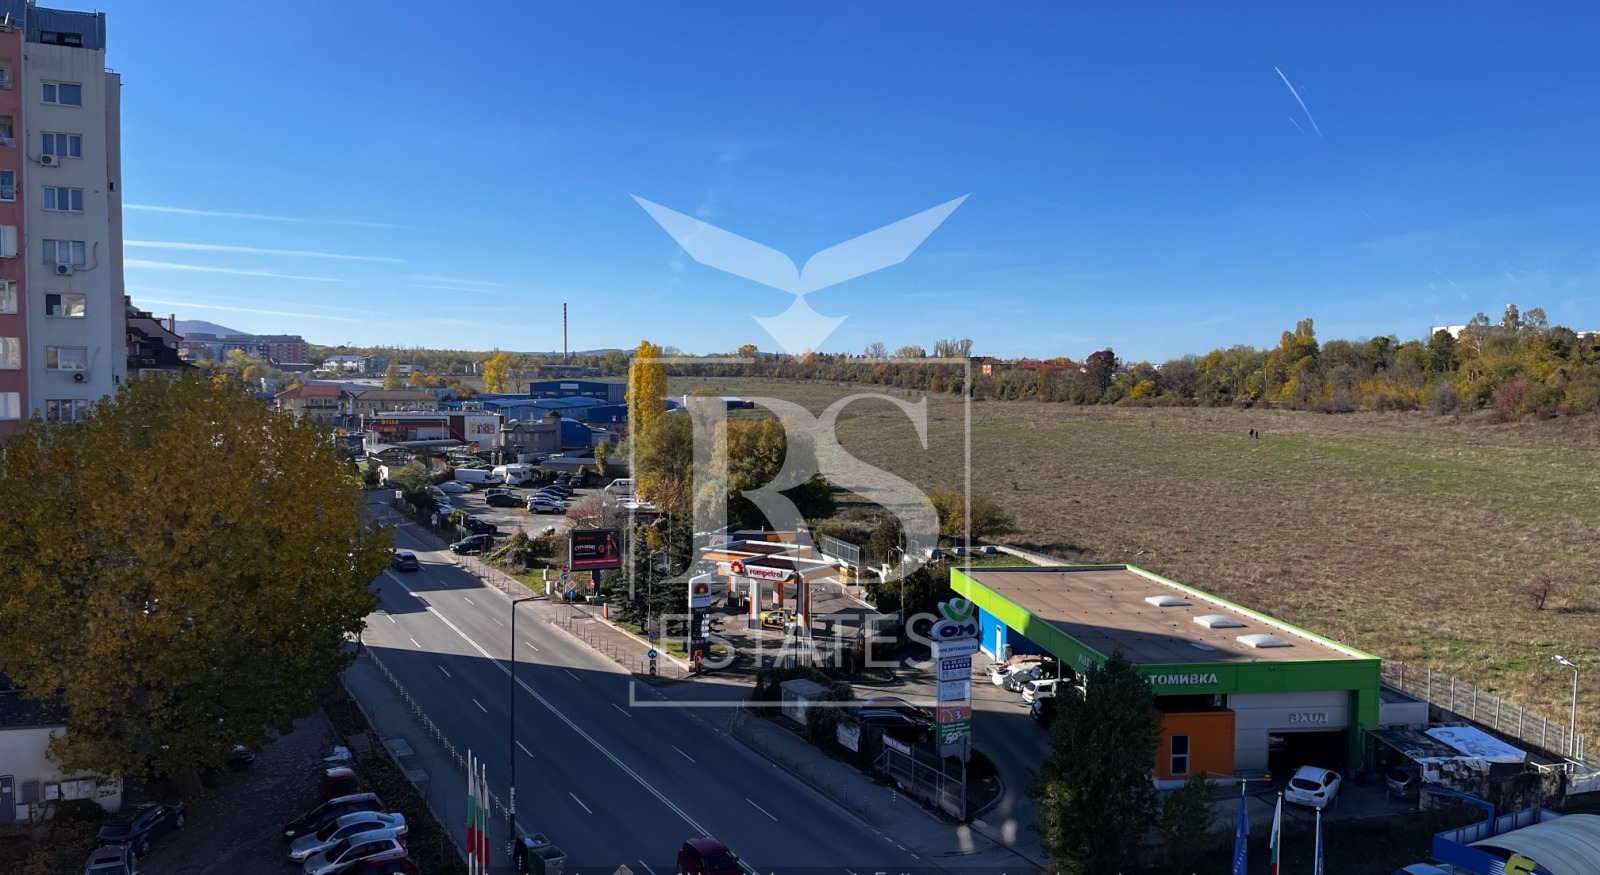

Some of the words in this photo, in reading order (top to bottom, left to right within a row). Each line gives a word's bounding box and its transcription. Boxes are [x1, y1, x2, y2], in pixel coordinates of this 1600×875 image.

[749, 568, 784, 578] rompetrol
[1144, 673, 1218, 685] ТОМИВКА
[1289, 711, 1329, 724] ВХОД
